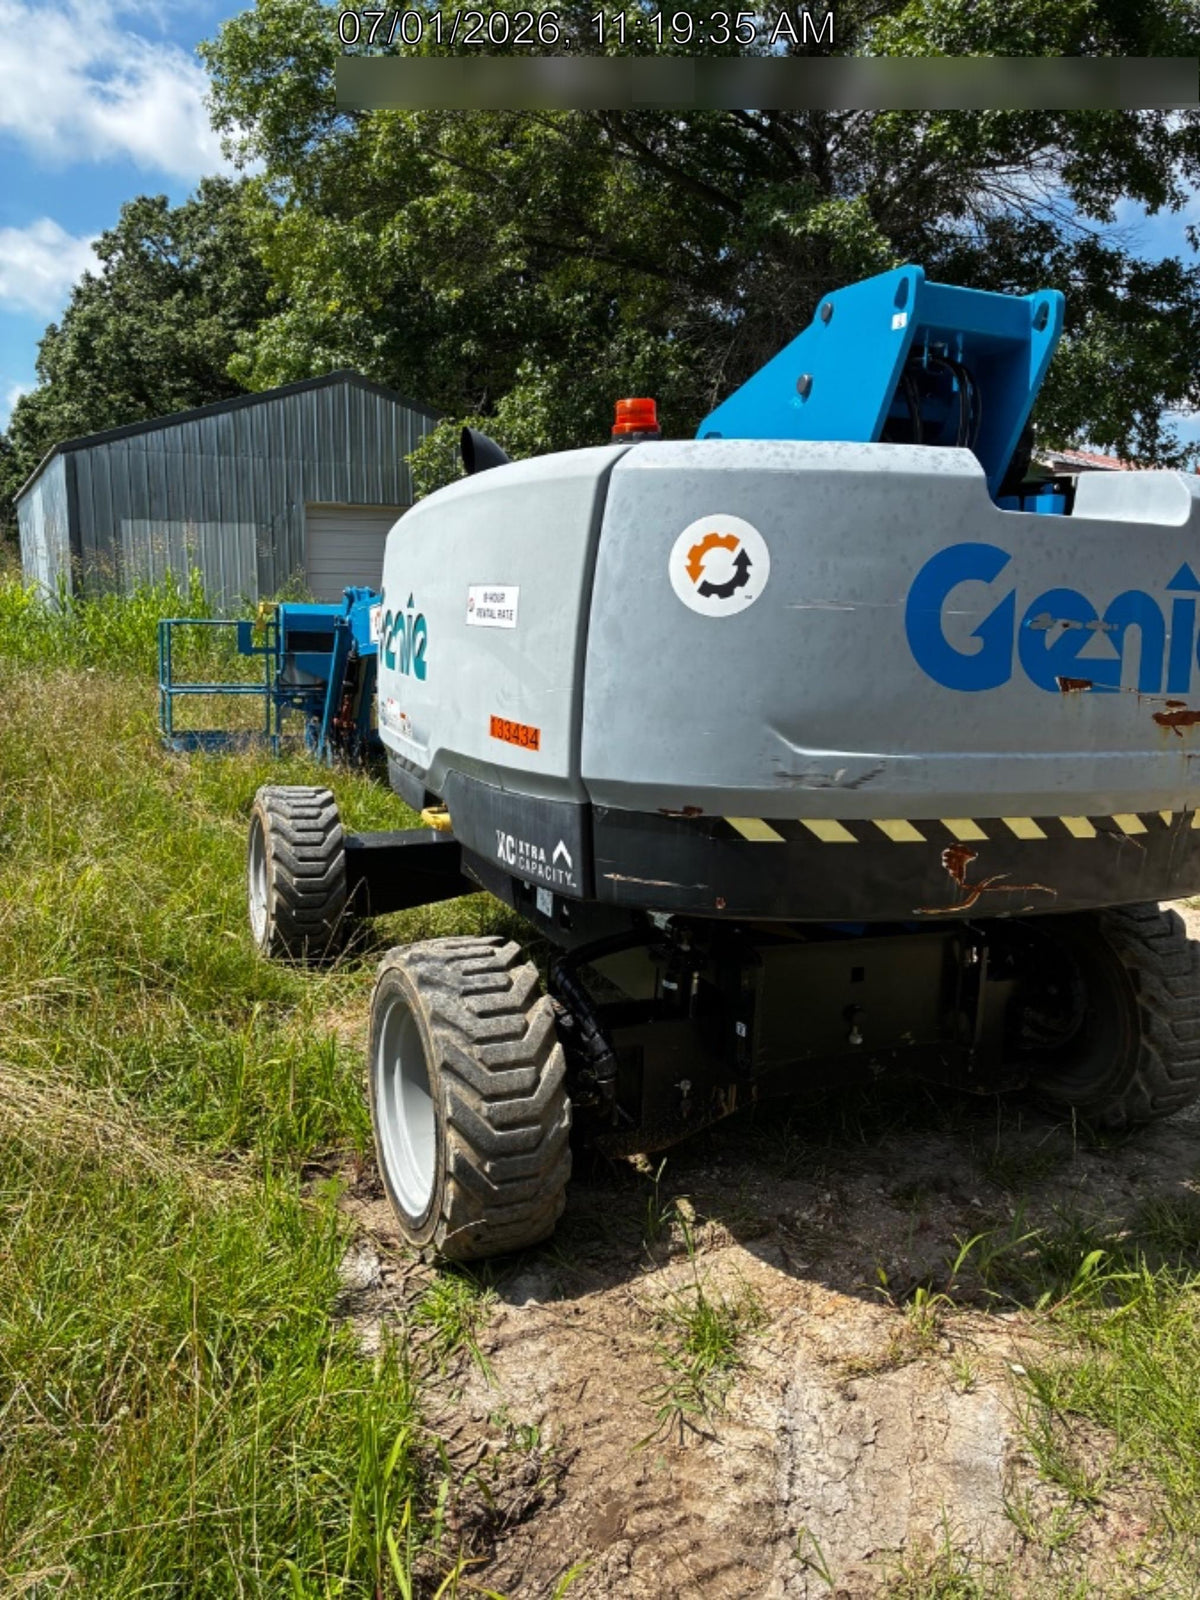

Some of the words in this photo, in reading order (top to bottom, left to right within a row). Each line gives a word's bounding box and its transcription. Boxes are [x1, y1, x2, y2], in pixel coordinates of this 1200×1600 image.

[497, 609, 514, 621] RATE
[905, 542, 1200, 693] Geni
[496, 829, 516, 865] XC
[518, 840, 546, 863] XTRA
[518, 856, 573, 886] CAPACITY
